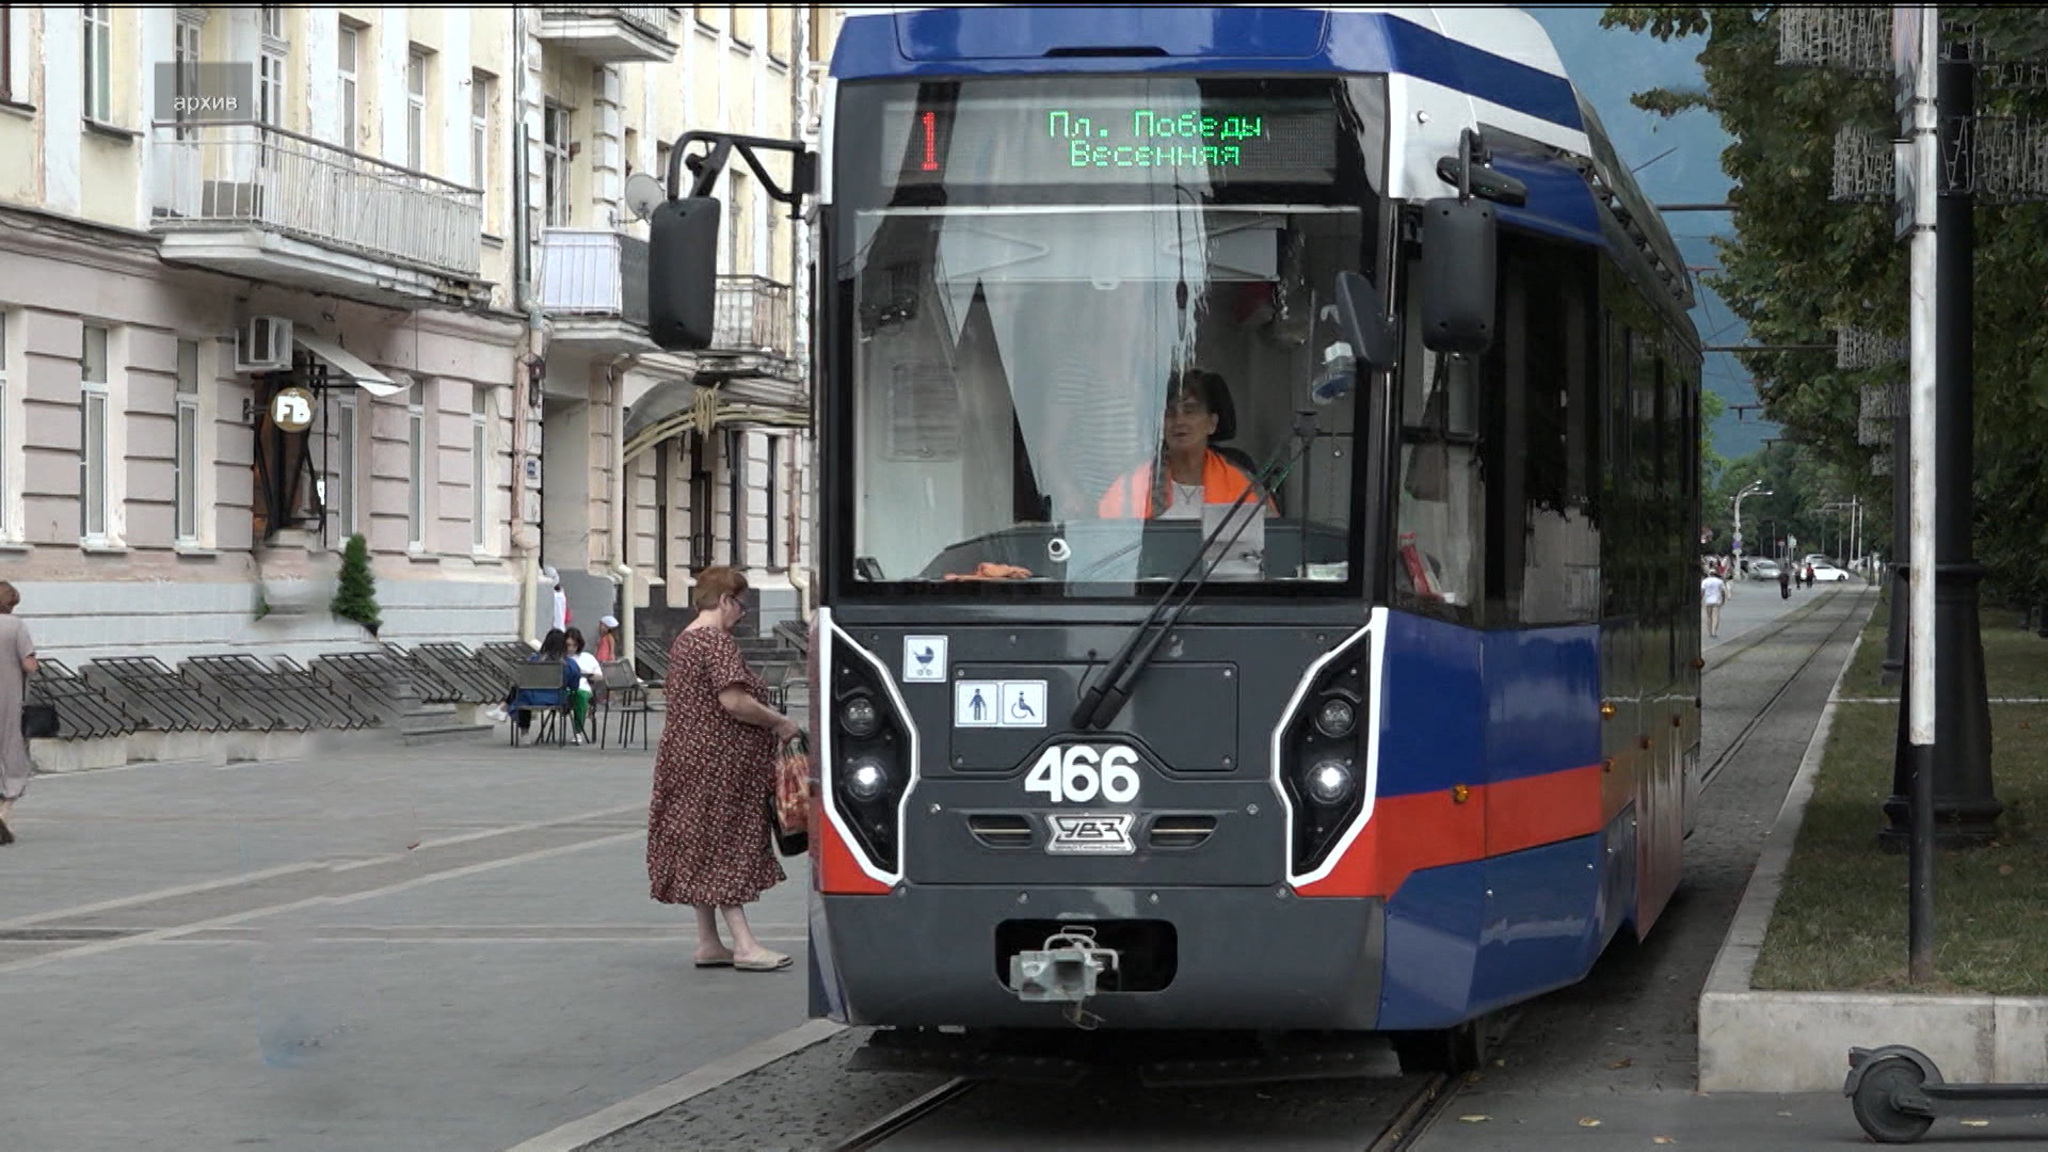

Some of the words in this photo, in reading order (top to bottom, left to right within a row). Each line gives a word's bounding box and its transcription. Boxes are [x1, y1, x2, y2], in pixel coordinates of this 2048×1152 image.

[921, 111, 938, 171] 1
[1050, 111, 1109, 138] Пл.
[1135, 110, 1261, 141] Победы
[1071, 140, 1240, 167] Весенняя
[1025, 745, 1140, 803] 466
